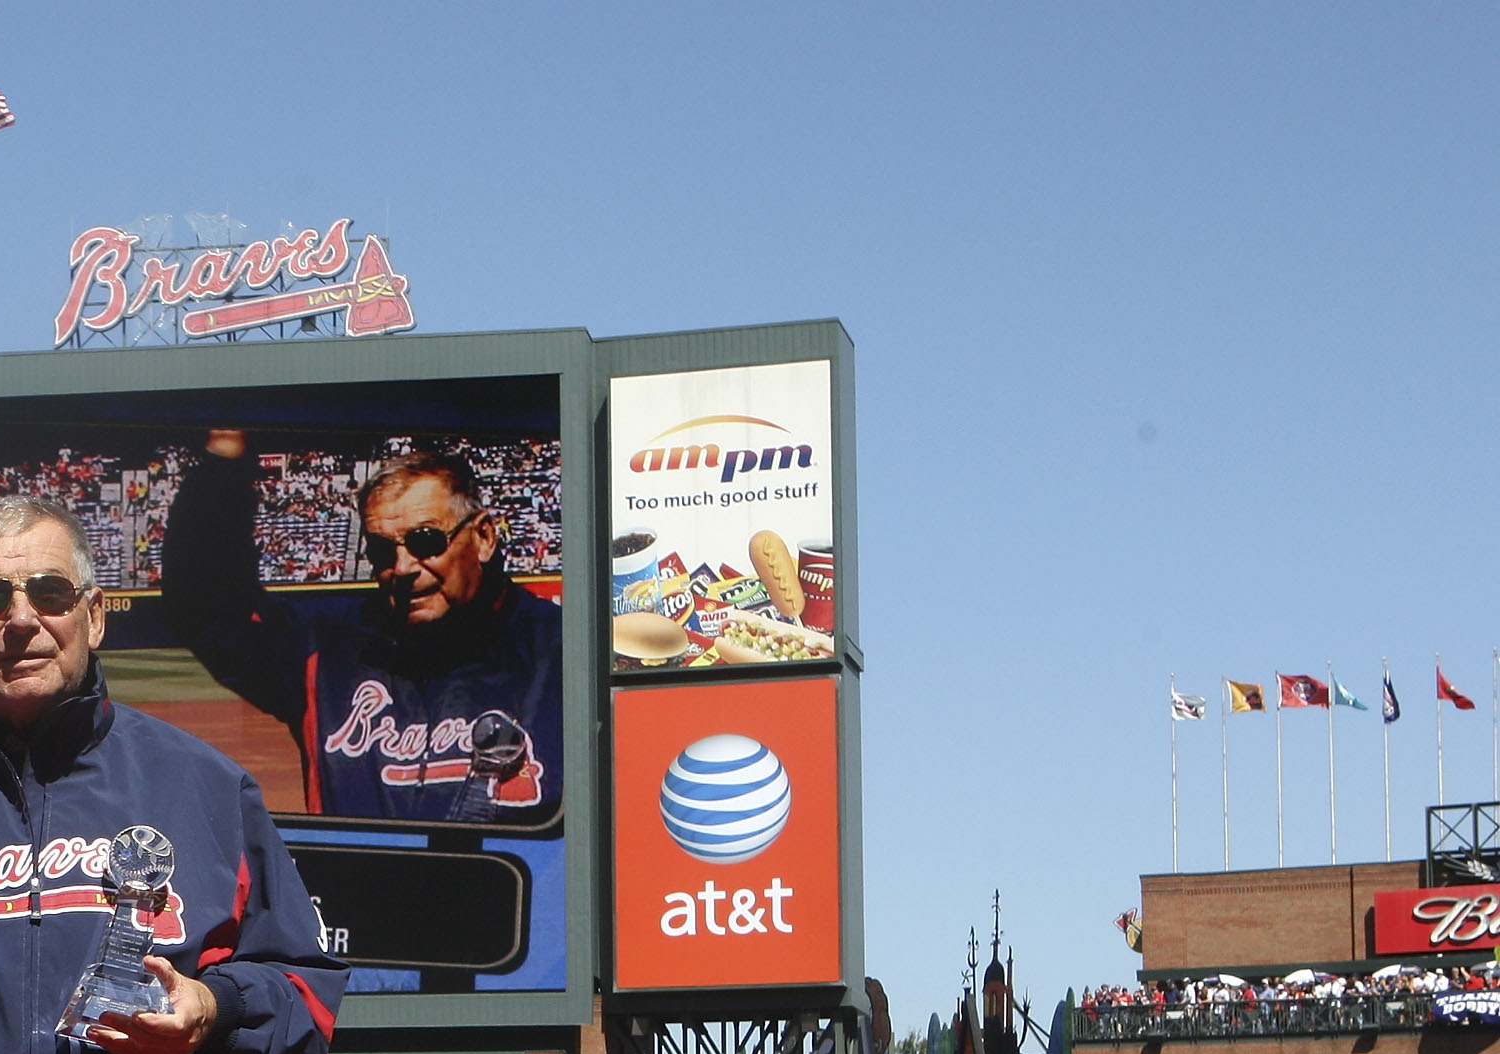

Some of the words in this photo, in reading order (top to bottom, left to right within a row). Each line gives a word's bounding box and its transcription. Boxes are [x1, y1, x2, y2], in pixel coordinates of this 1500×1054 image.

[54, 217, 354, 350] Braves
[629, 443, 813, 483] ampm
[625, 496, 659, 510] Too
[664, 491, 713, 508] much
[720, 486, 767, 507] good
[774, 482, 819, 500] stuff
[104, 598, 131, 612] 380
[660, 877, 793, 937] at&t
[1413, 893, 1500, 944] B
